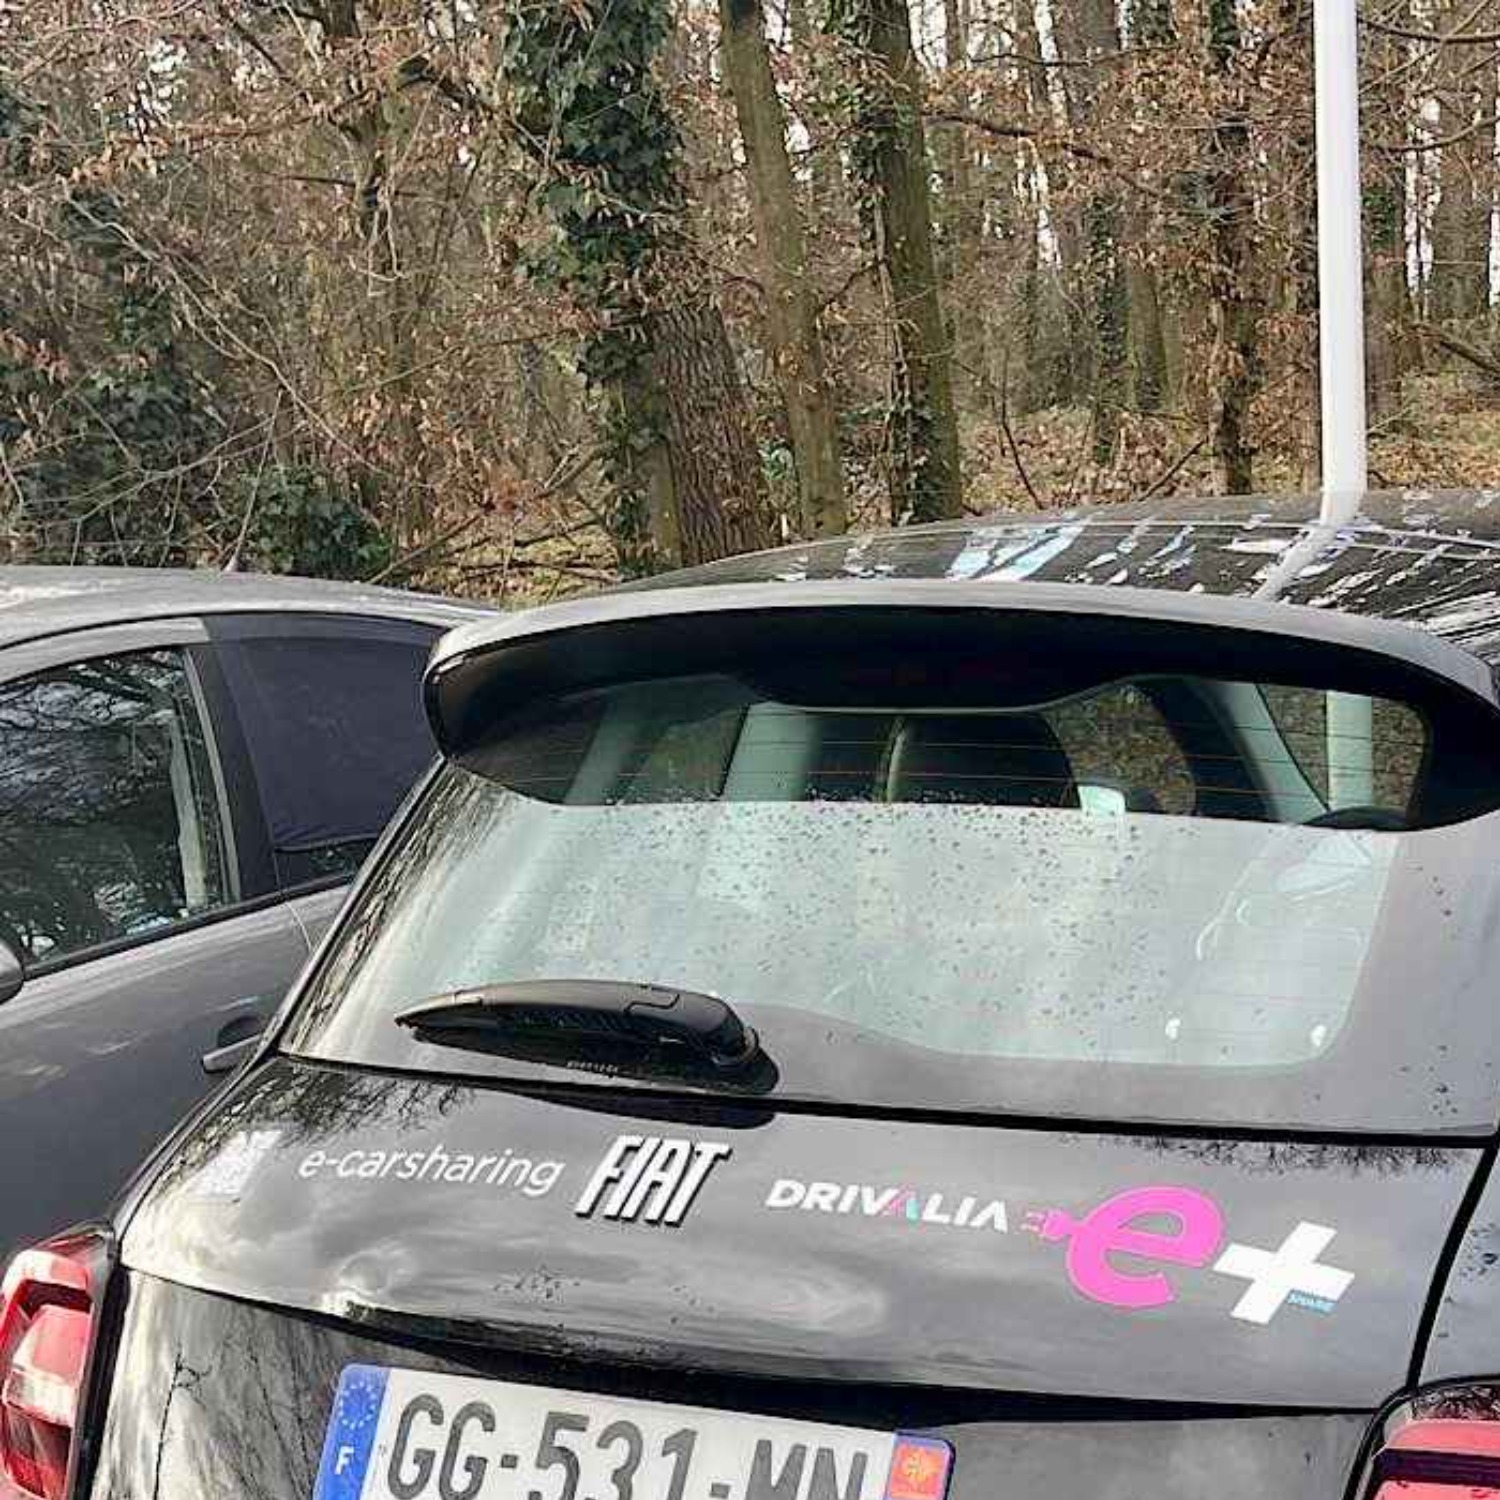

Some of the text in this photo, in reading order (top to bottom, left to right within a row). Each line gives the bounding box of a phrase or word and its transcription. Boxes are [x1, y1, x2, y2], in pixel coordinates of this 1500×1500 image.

[299, 1144, 565, 1196] e-carsharing
[576, 1135, 731, 1227] FIAT
[765, 1179, 1010, 1235] DRIVALIA
[336, 1445, 355, 1475] F
